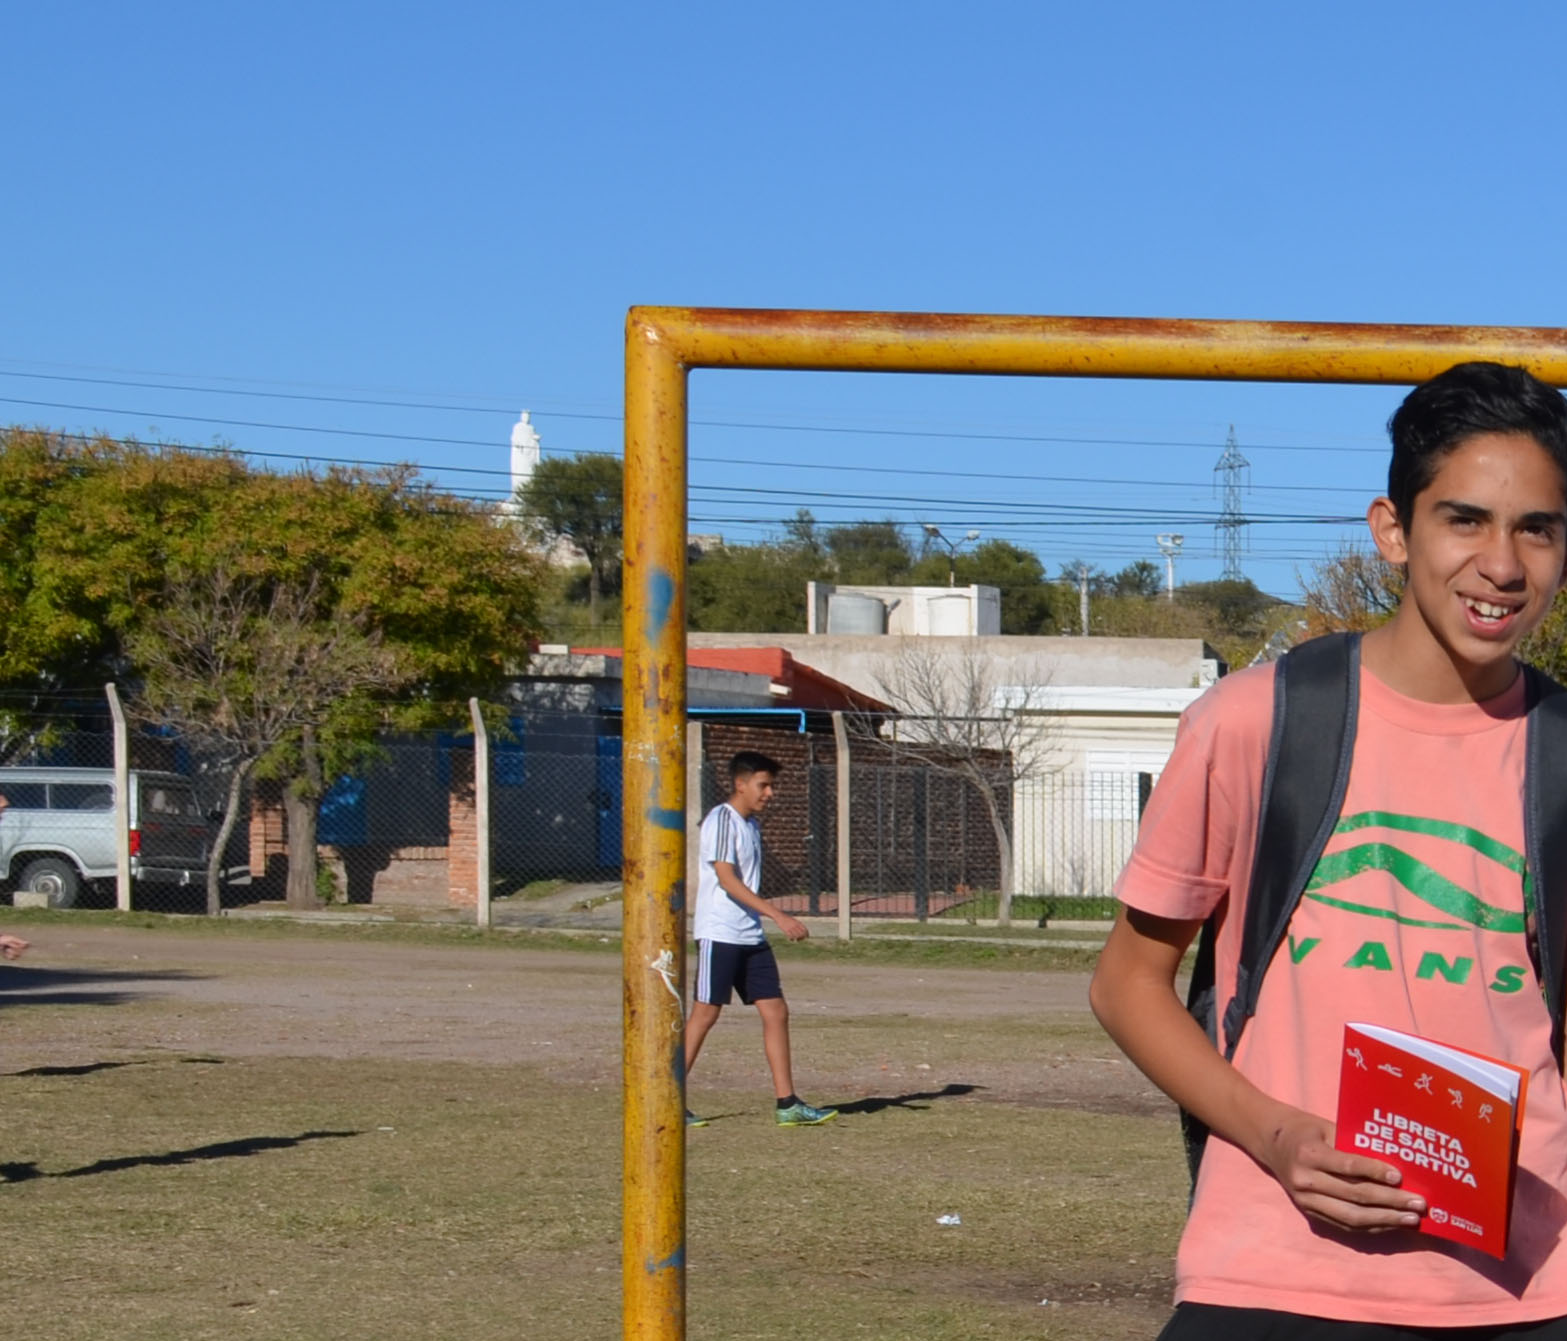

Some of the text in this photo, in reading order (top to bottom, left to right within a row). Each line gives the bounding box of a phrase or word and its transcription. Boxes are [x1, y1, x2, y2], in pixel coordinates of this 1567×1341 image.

[1288, 935, 1527, 993] VANS
[1364, 1120, 1470, 1169] DE SALUD
[1373, 1108, 1463, 1153] LIBRETA
[1355, 1133, 1477, 1188] DEPORTIVA
